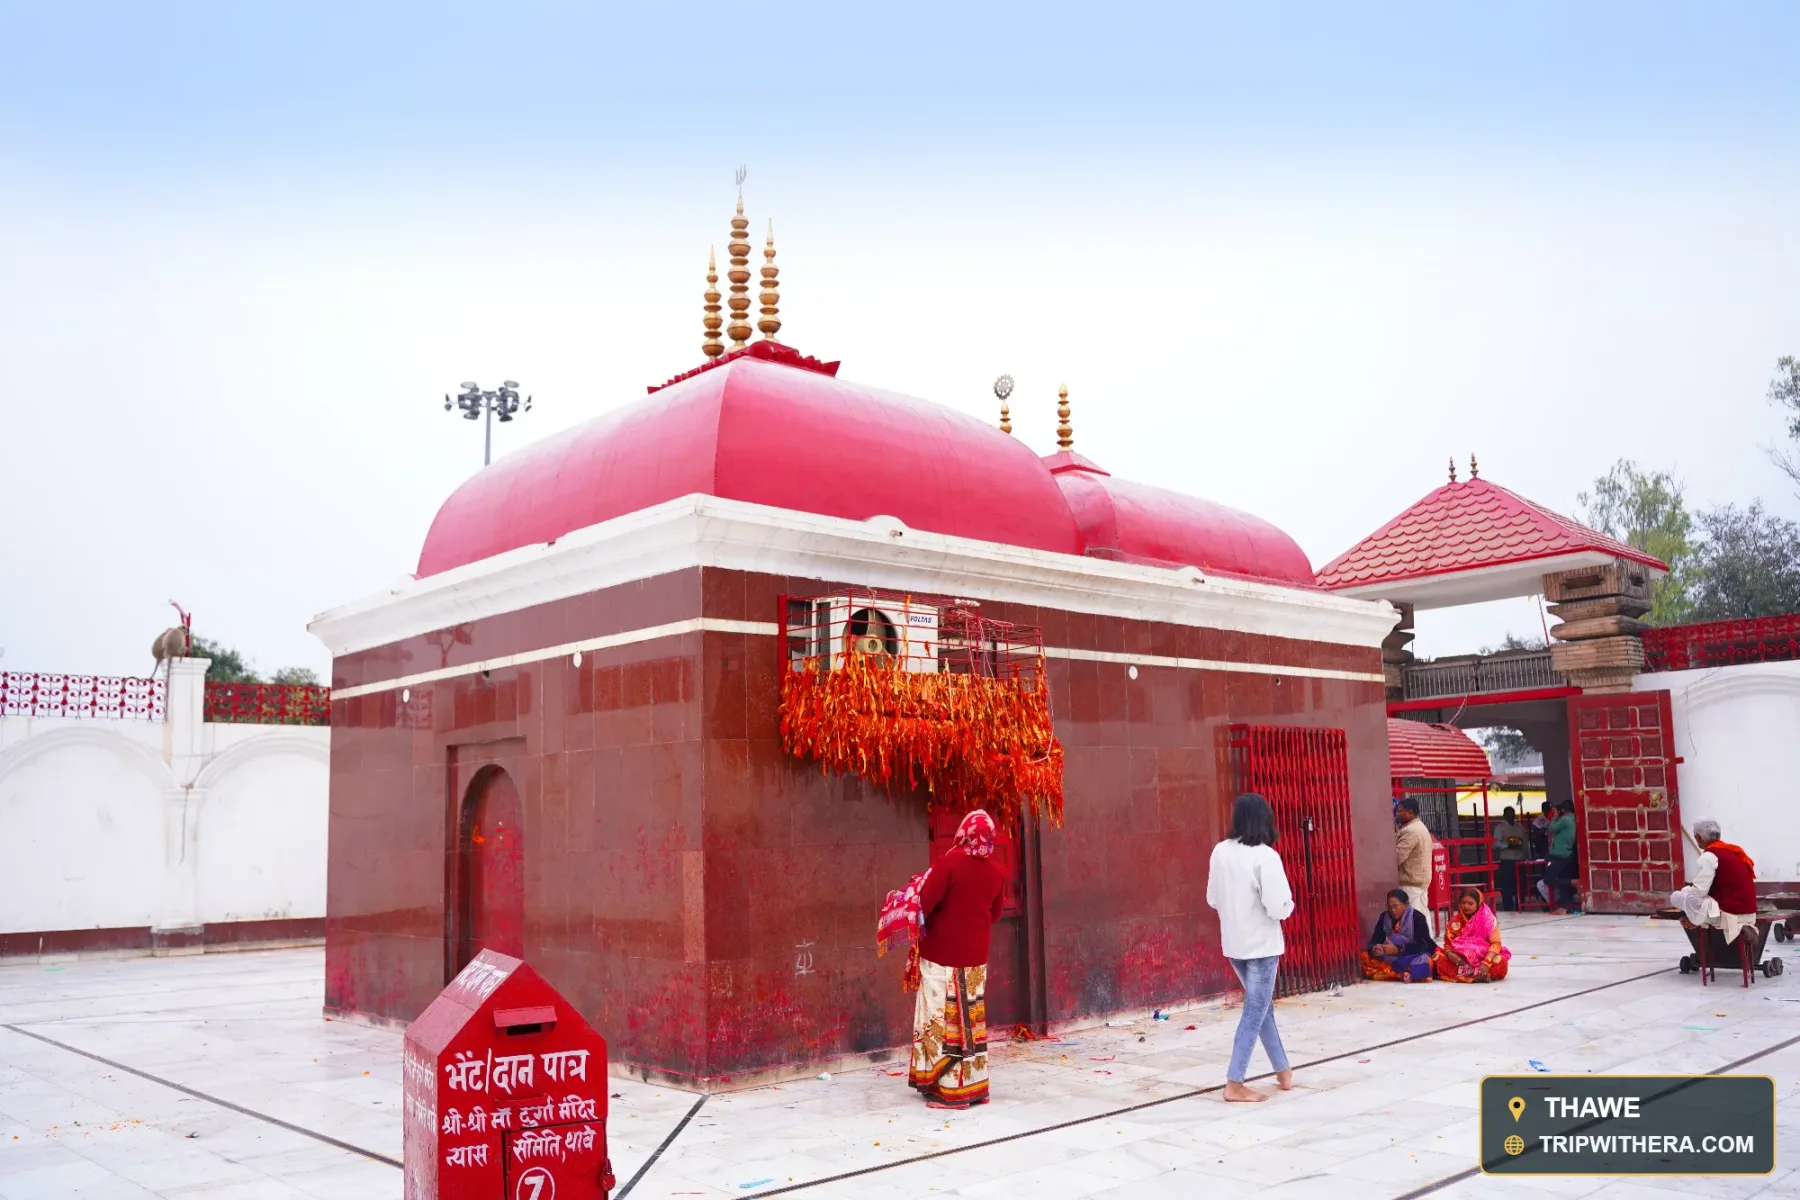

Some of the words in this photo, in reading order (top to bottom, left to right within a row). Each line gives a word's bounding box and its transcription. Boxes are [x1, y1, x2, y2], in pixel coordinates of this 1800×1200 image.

[909, 615, 932, 624] VOLTAS
[540, 1049, 591, 1082] पात्र
[519, 1095, 554, 1127] दुर्गा
[558, 1094, 598, 1120] मंदिर
[446, 1144, 489, 1167] न्यास
[524, 1175, 545, 1200] 7
